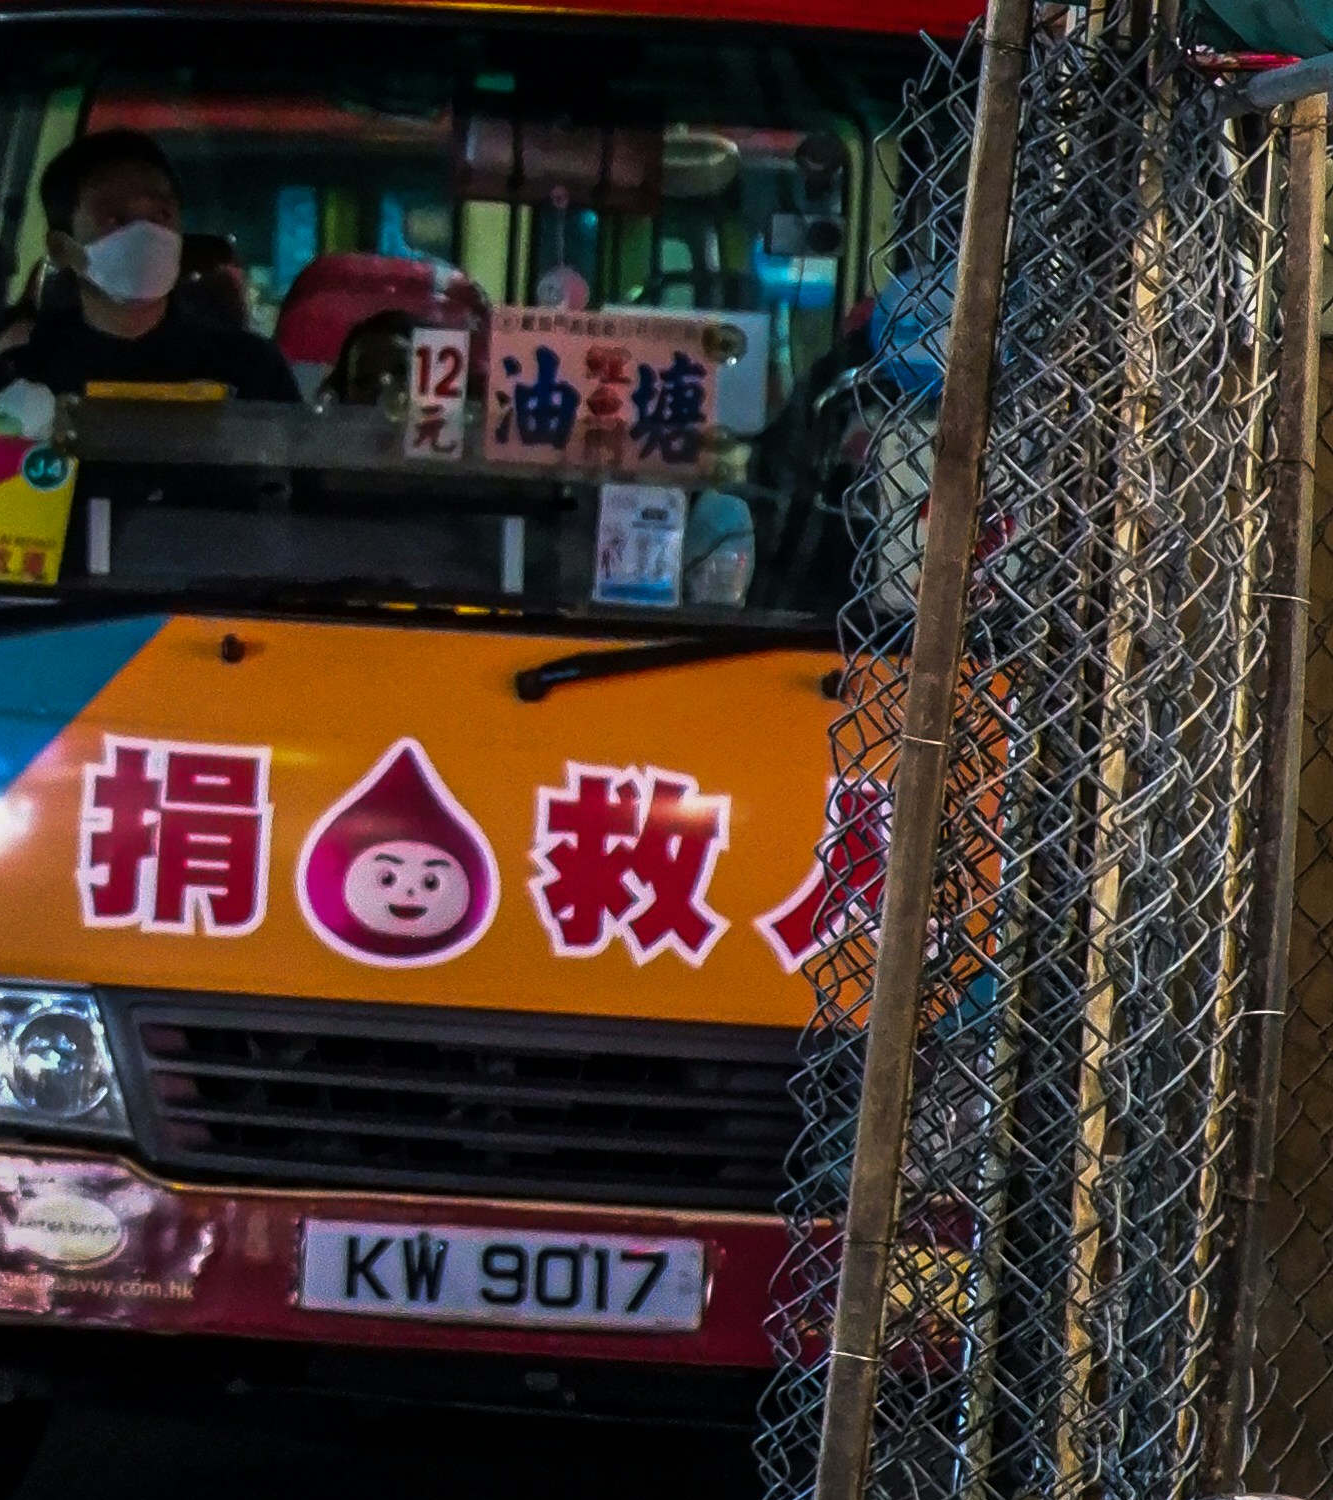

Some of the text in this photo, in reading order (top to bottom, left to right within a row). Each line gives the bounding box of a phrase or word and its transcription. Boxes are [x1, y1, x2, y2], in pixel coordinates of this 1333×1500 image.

[415, 345, 463, 396] 12
[412, 404, 458, 453] 元
[78, 734, 274, 939] 捐
[346, 1233, 668, 1314] KW 9017
